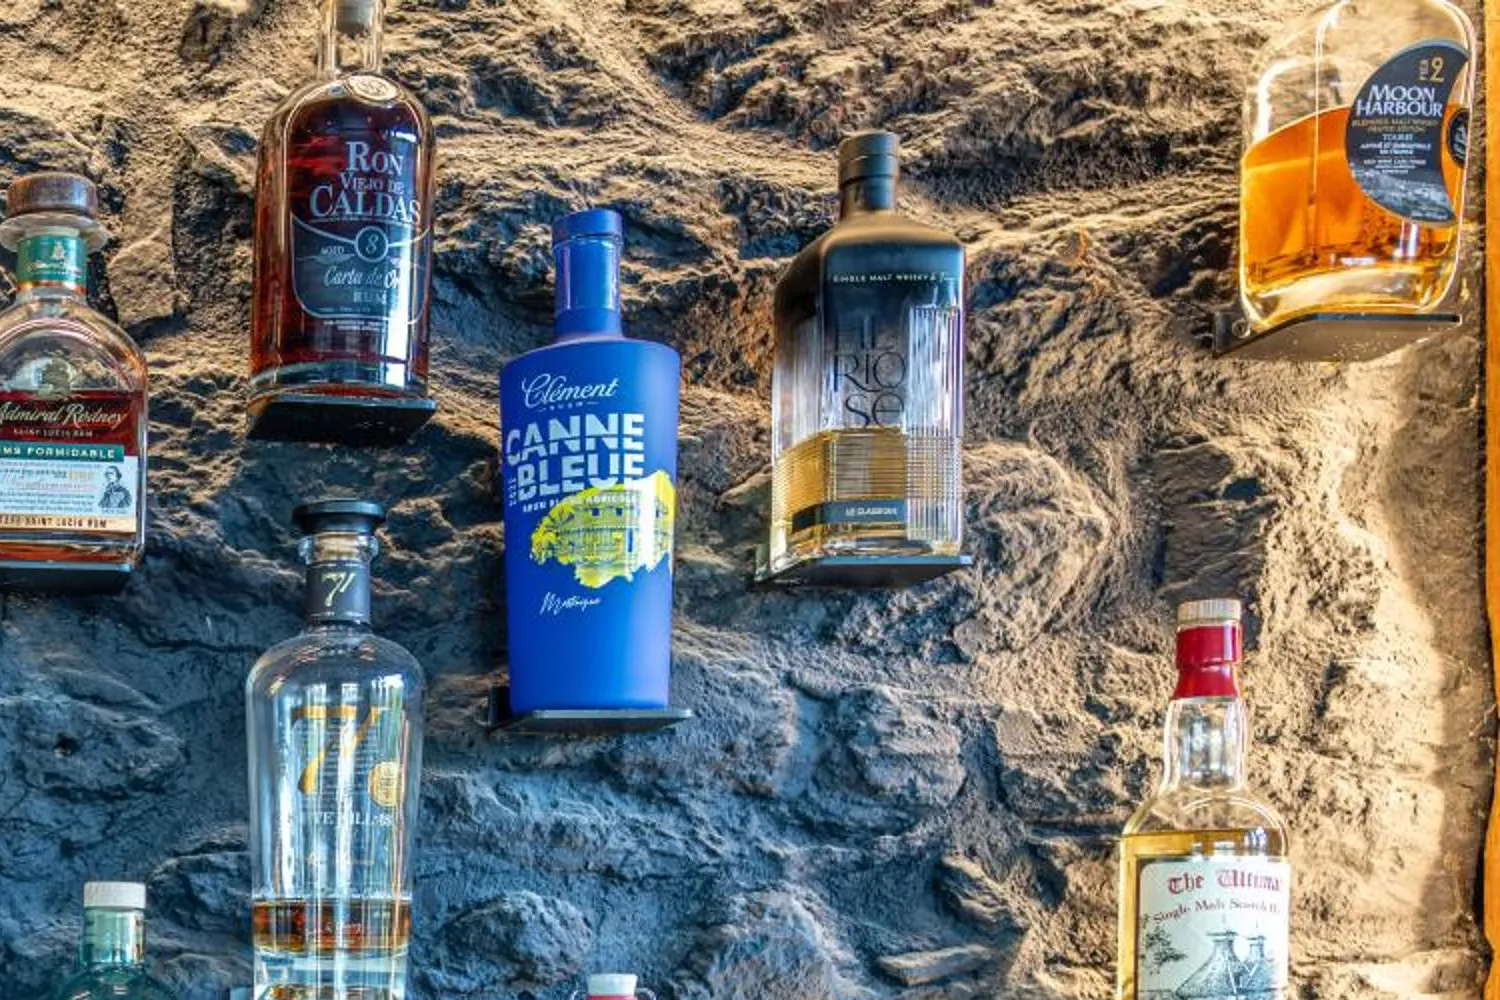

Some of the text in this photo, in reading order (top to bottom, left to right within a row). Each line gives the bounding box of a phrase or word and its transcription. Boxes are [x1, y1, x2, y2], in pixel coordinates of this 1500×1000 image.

[1429, 56, 1445, 82] 2
[1368, 84, 1436, 100] MOON
[1355, 99, 1444, 117] HARBOUR
[345, 141, 404, 177] RON
[340, 171, 384, 192] VIEJO
[309, 184, 421, 225] CALDAS
[365, 233, 379, 253] 8
[323, 265, 364, 287] Carta
[521, 373, 619, 410] Clément
[64, 402, 128, 430] Rodney
[505, 413, 645, 467] CANNE
[26, 447, 116, 458] FORMIDABLE
[516, 453, 645, 502] BLEUE
[1167, 872, 1205, 895] The
[1153, 904, 1191, 925] Single
